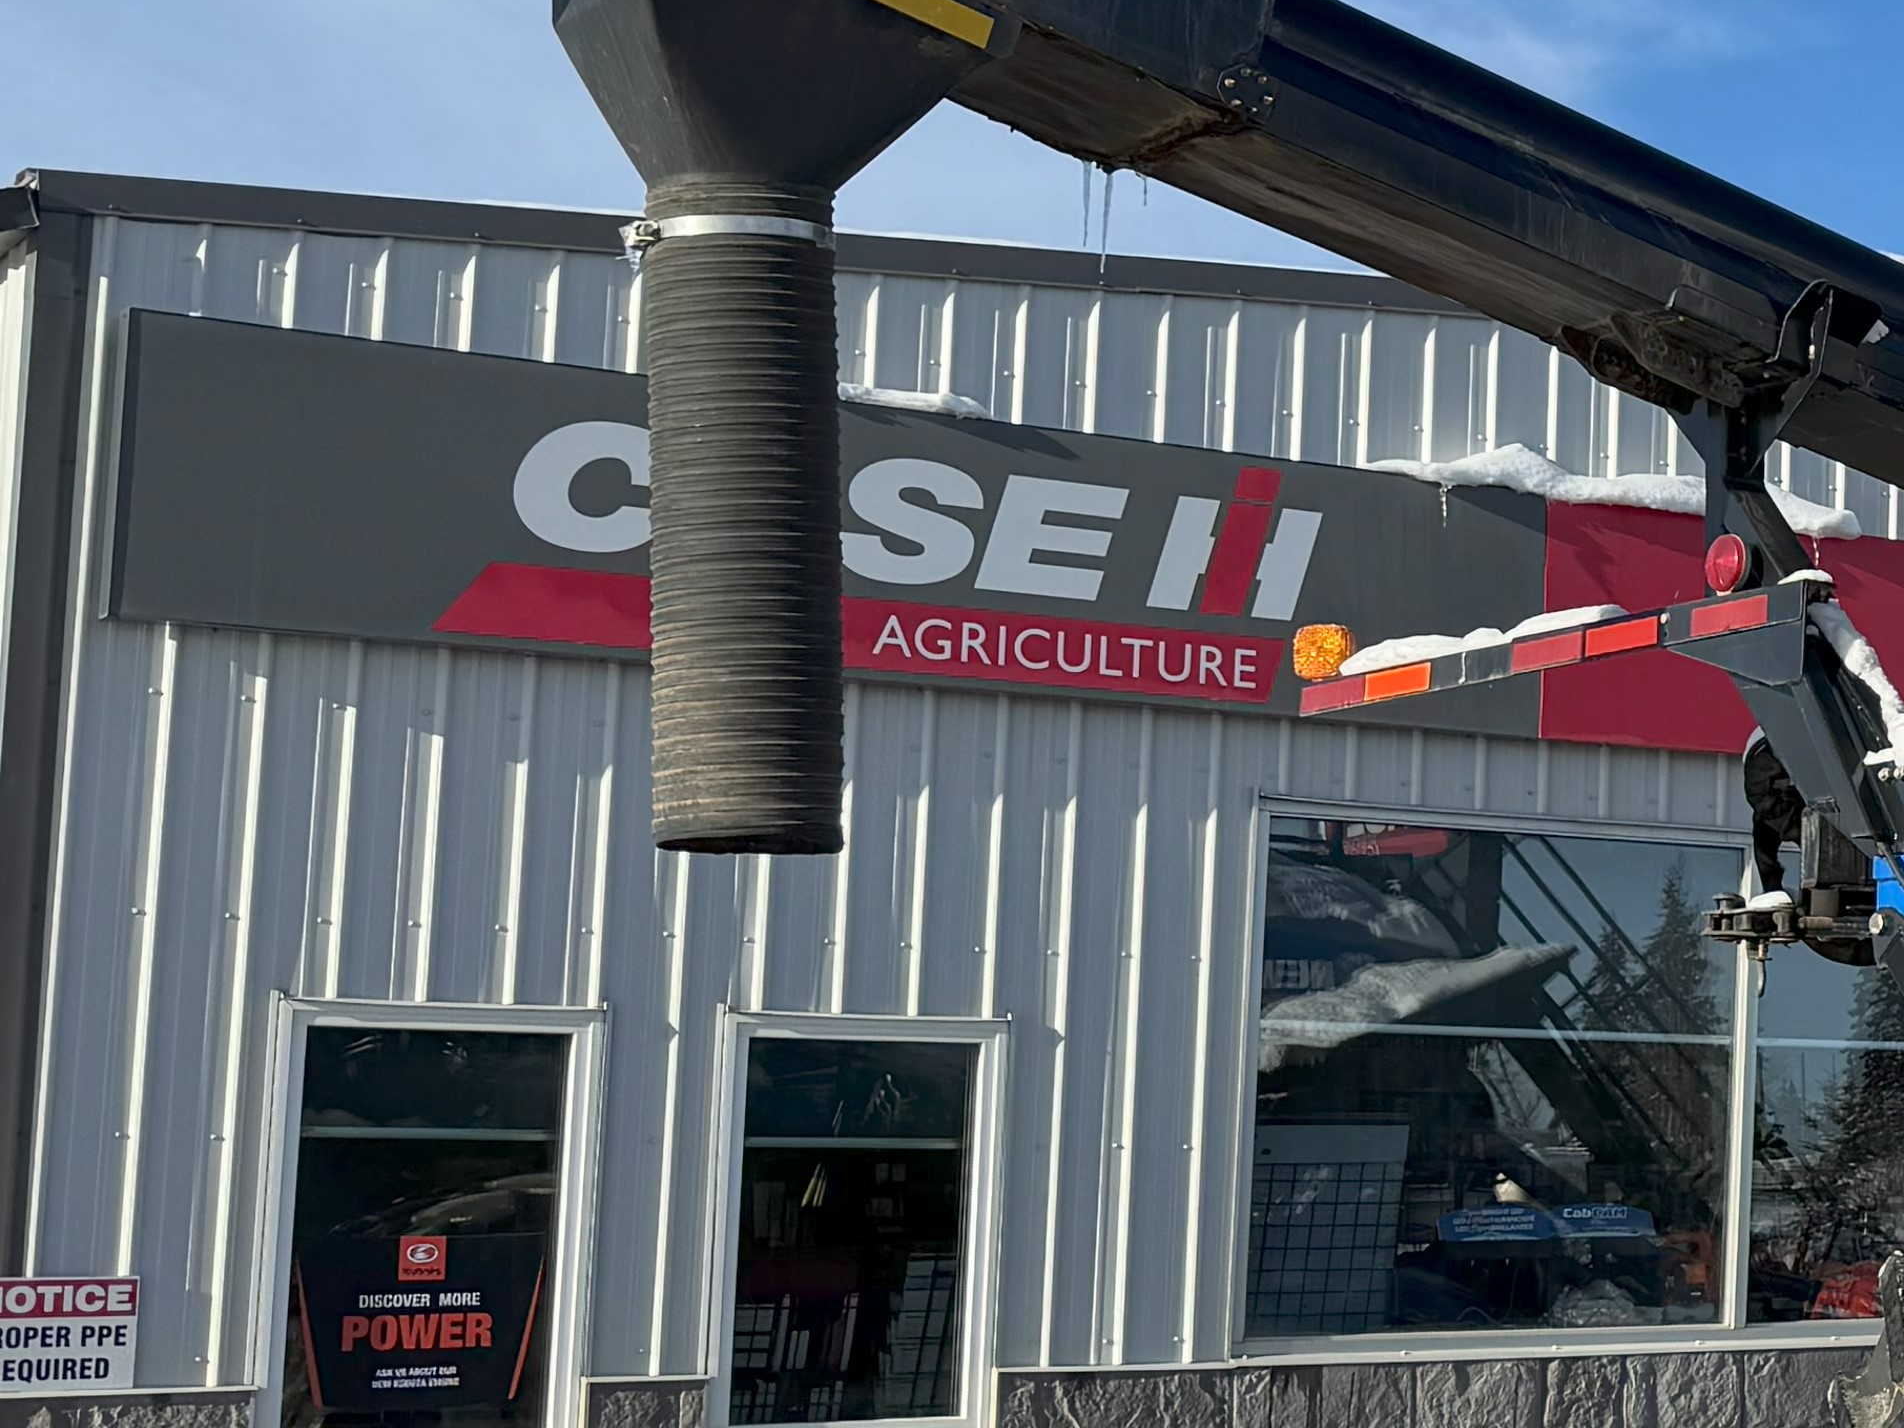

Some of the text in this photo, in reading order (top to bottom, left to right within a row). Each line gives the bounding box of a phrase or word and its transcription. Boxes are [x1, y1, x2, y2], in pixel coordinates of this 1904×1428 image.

[513, 420, 1129, 601] CSE
[872, 613, 1258, 690] AGRICULTURE
[0, 1284, 132, 1314] OTICE
[358, 1292, 481, 1309] DISCOVER MORE
[0, 1324, 128, 1349] OPER PPE
[341, 1312, 493, 1352] POWER
[2, 1357, 110, 1384] EQUIRED
[408, 1366, 437, 1376] ABOUT
